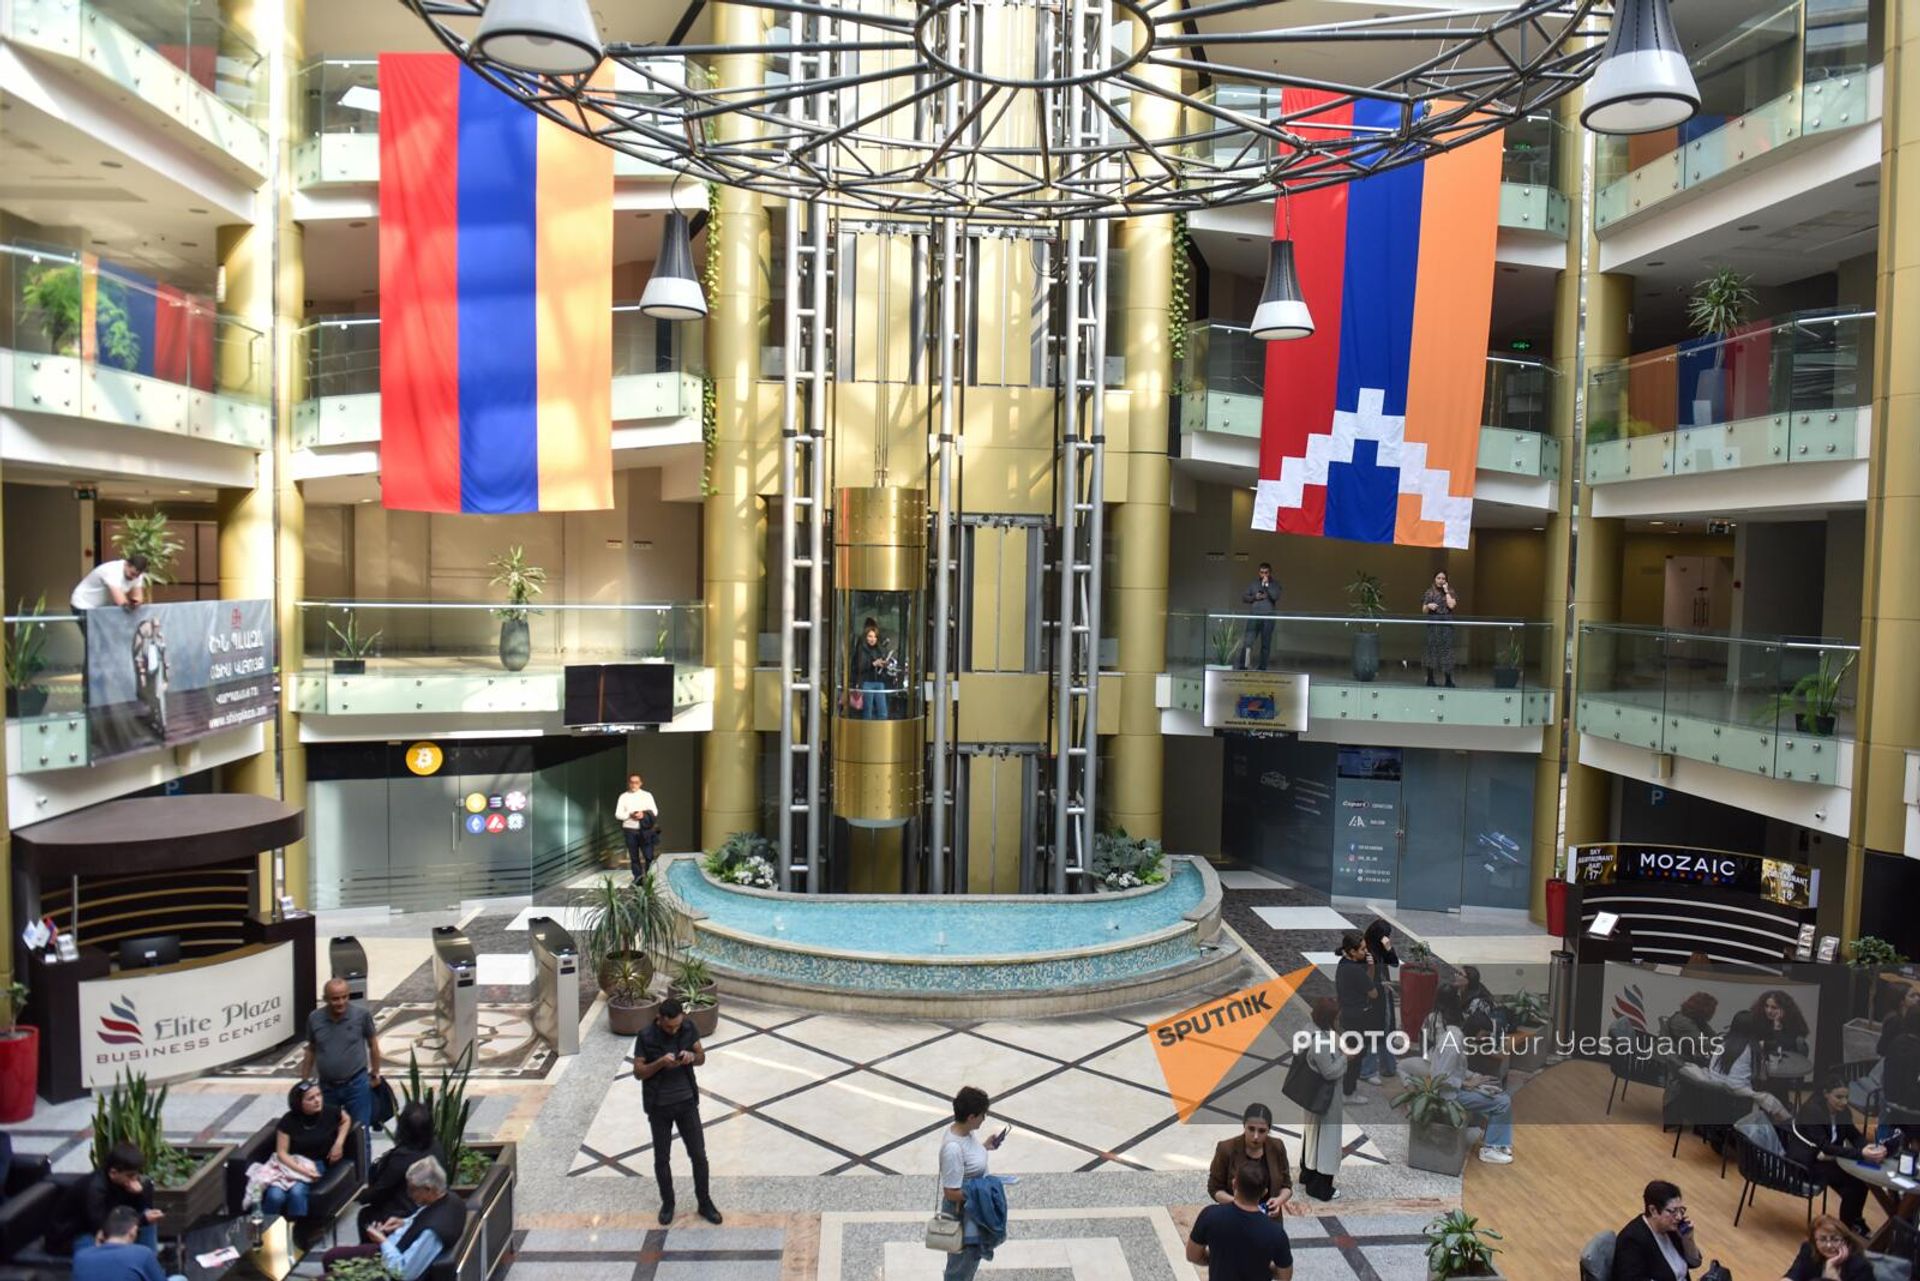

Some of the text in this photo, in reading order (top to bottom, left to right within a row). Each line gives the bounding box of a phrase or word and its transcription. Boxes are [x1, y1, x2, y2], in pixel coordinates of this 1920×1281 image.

[1651, 790, 1663, 805] P
[1640, 853, 1735, 876] MOZAIC
[154, 995, 281, 1041] Elite Plaza
[96, 1014, 281, 1064] BUSINESS CENTER
